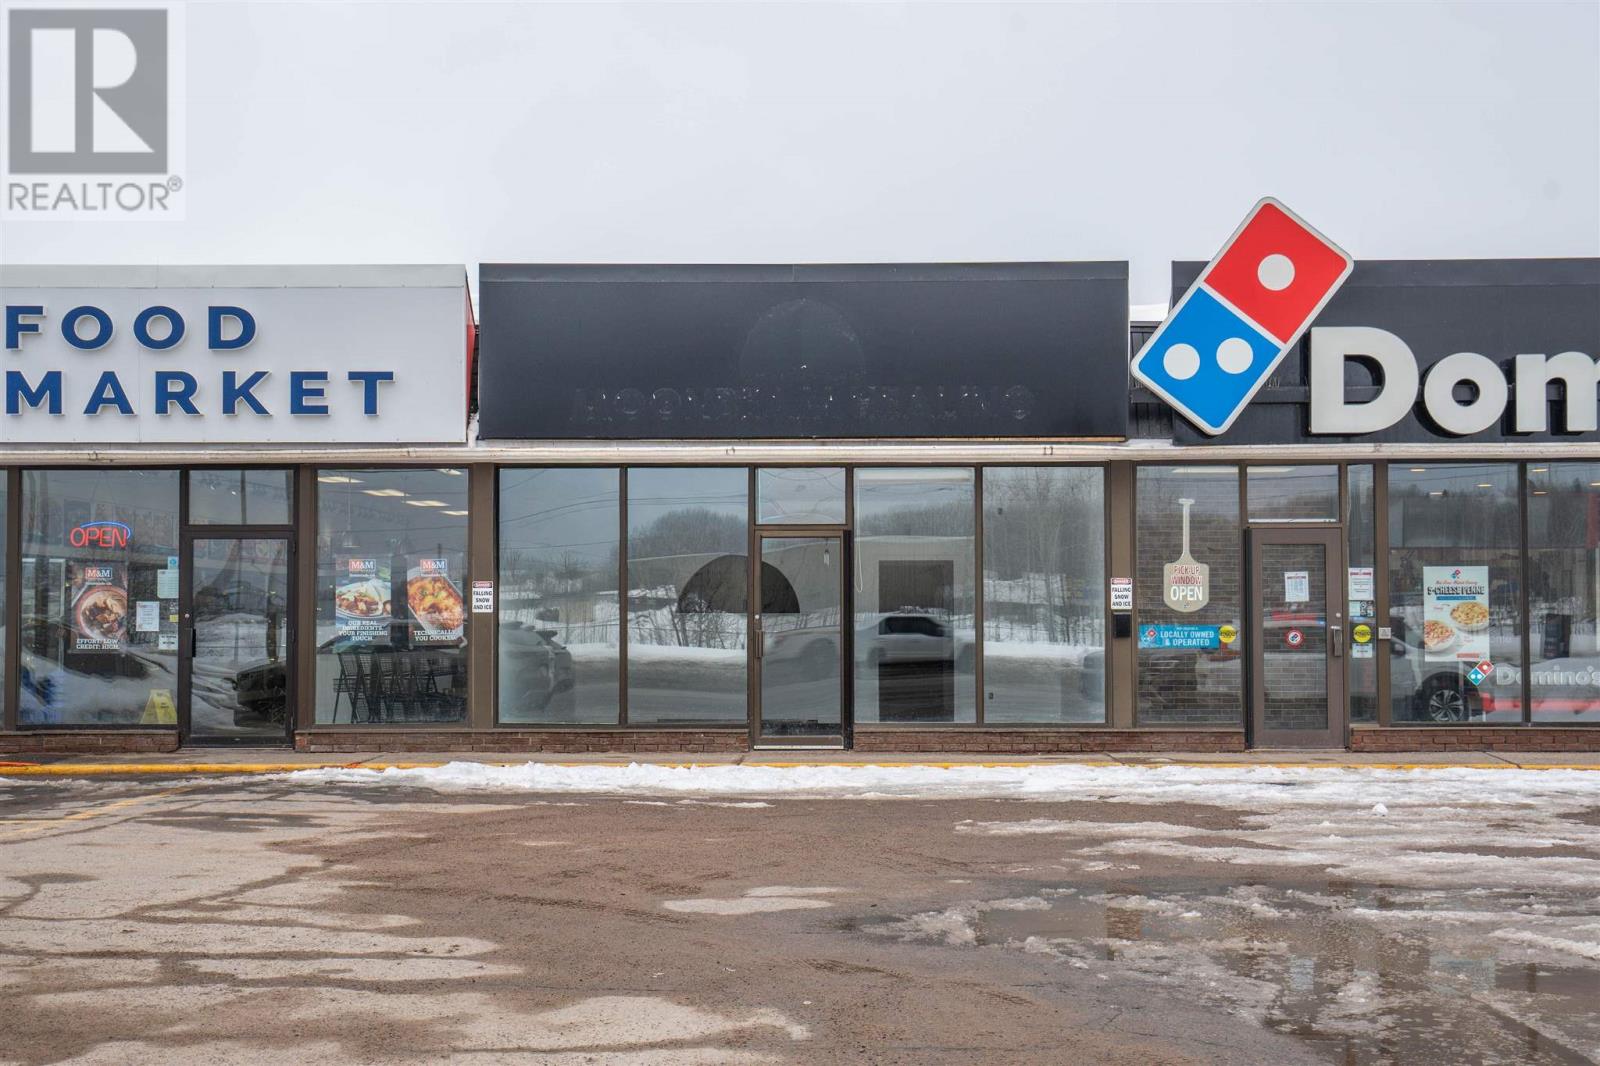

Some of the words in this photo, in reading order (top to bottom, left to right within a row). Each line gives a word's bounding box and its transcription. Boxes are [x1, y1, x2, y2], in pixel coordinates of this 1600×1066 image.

[5, 305, 258, 350] FOOD
[5, 370, 396, 416] MARKET
[70, 526, 128, 549] OPEN
[351, 560, 374, 569] M&M
[422, 560, 445, 569] M&M
[87, 568, 112, 578] M&M
[1174, 565, 1200, 575] PICK-UP
[1171, 575, 1202, 585] WINDOW
[1170, 586, 1203, 601] OPEN
[1160, 630, 1189, 638] LOCALLY
[1190, 630, 1215, 638] OWNED
[1172, 638, 1210, 646] OPERATED
